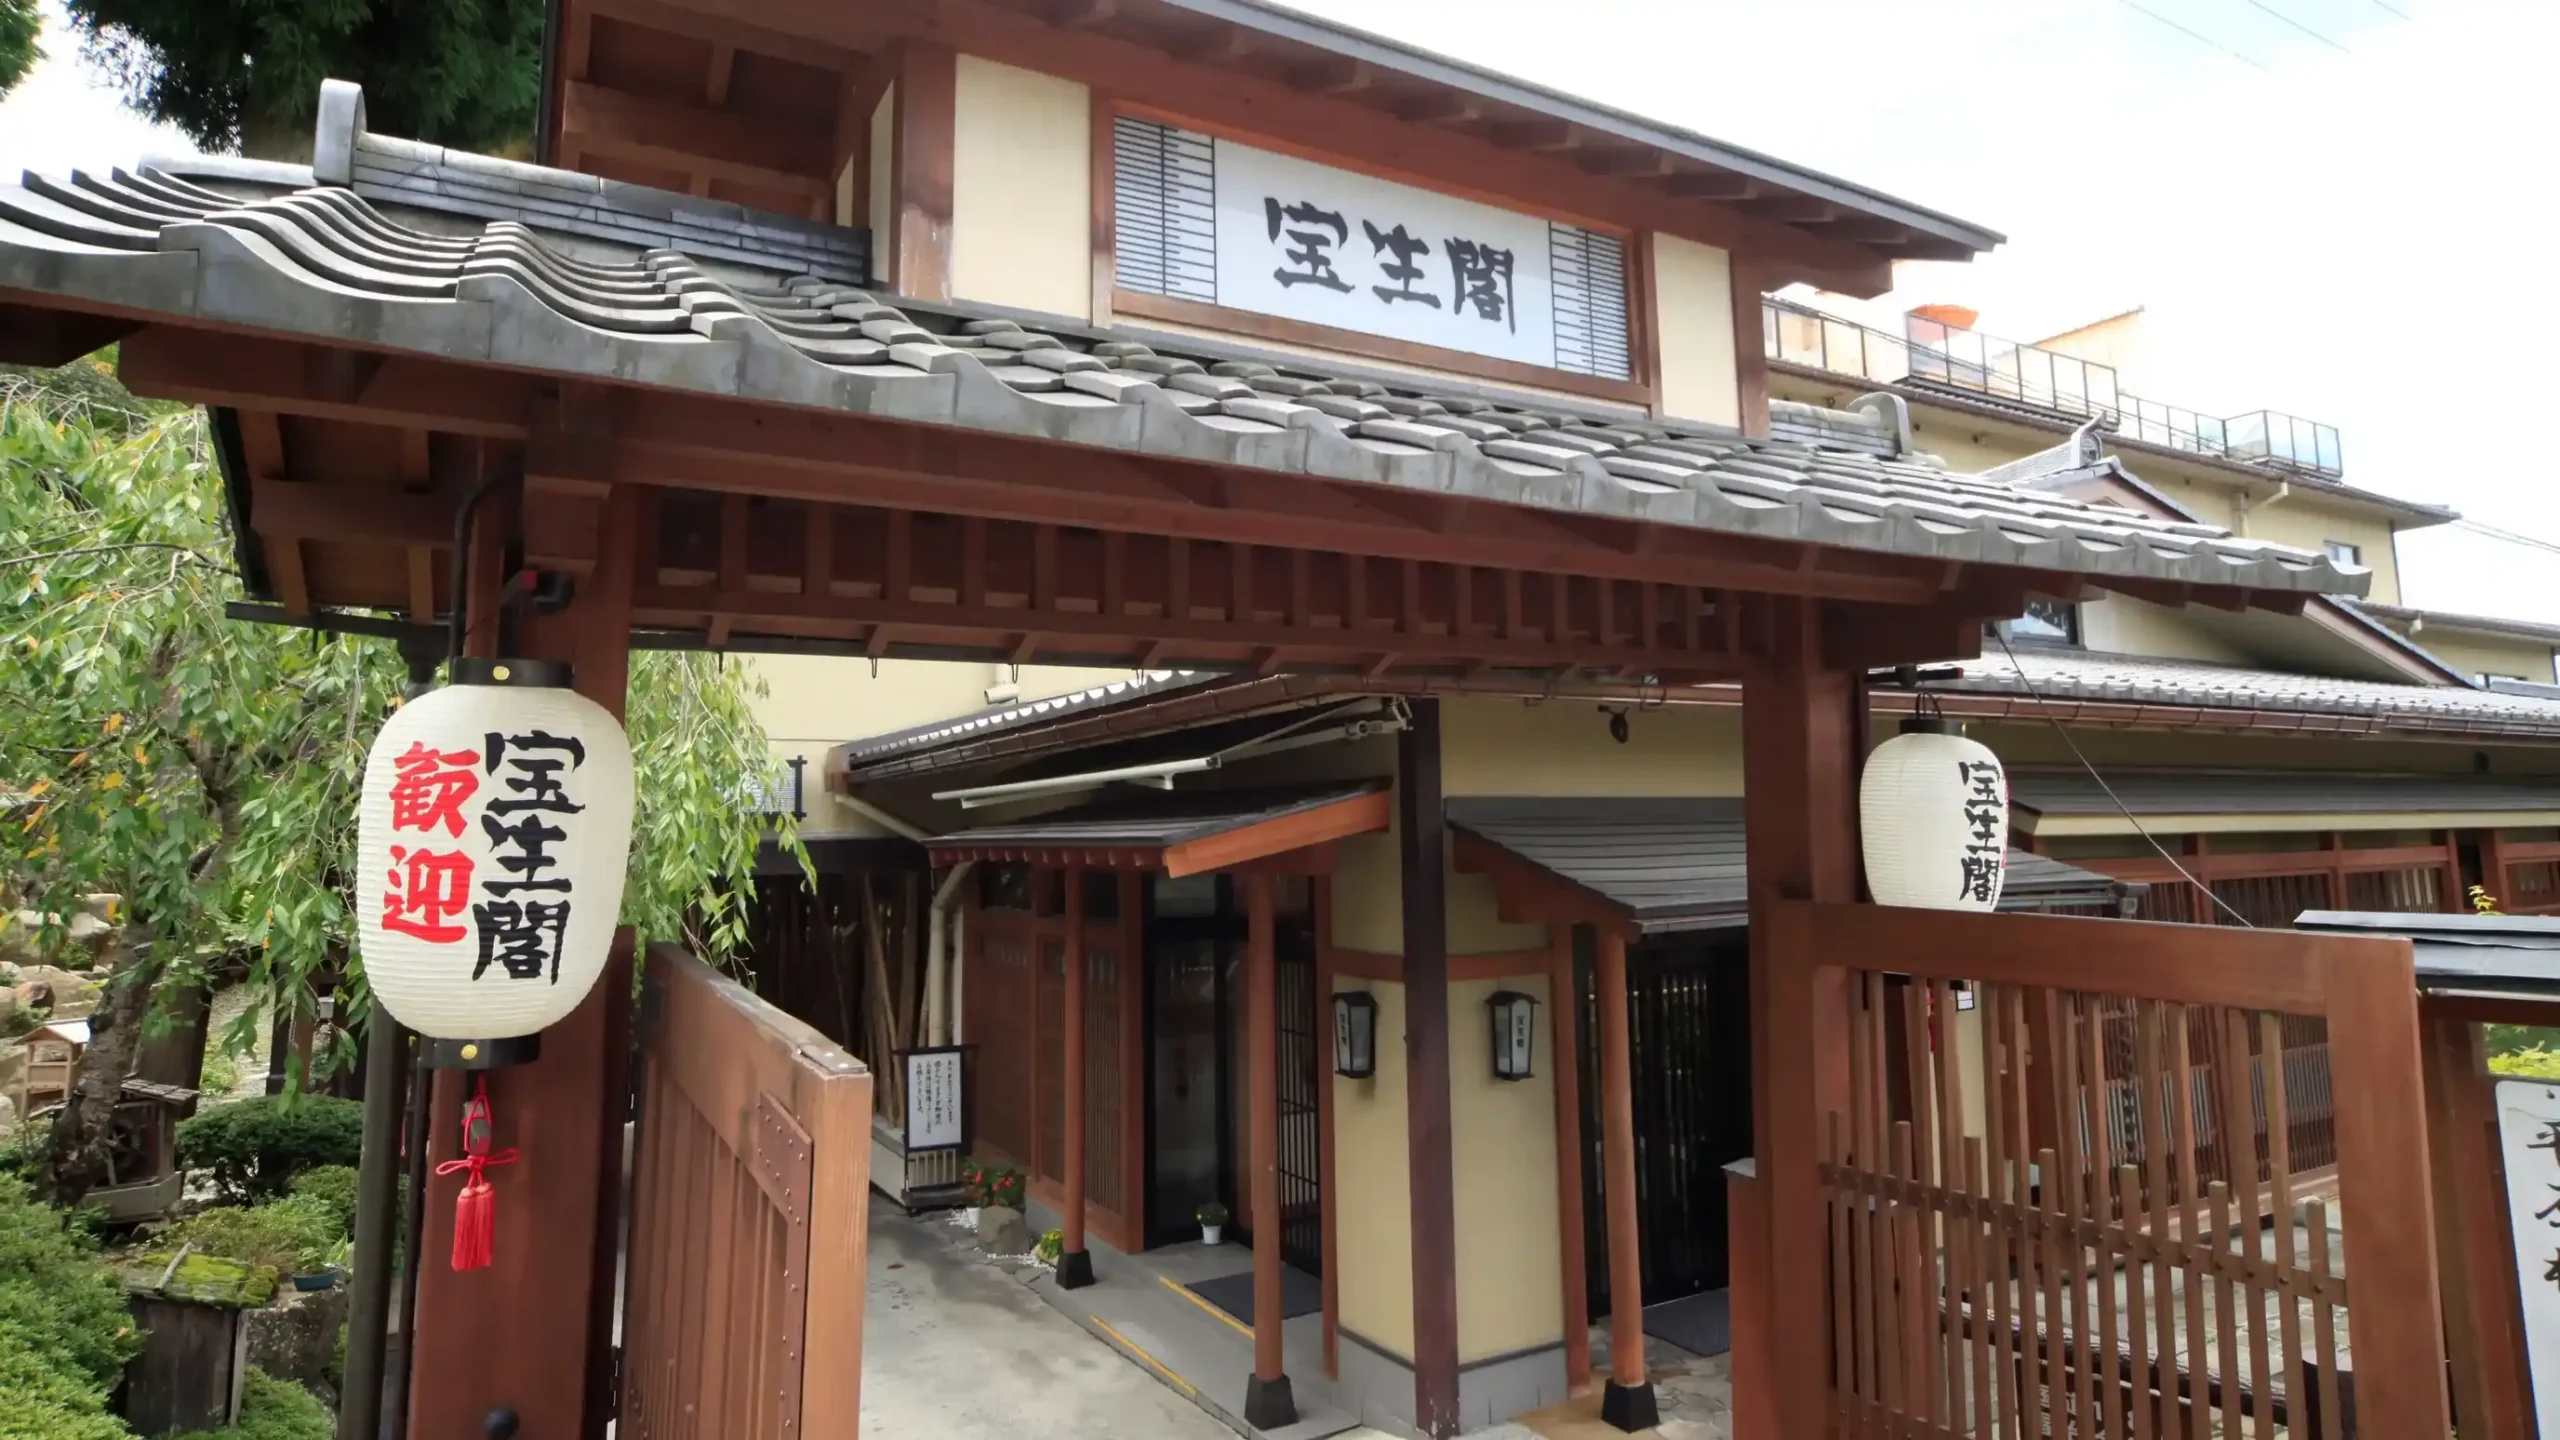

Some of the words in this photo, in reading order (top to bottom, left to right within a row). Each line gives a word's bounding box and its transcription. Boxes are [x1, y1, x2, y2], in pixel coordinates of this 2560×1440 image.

[1264, 197, 1515, 336] 宝生閣
[472, 729, 586, 986] 宝生閣
[1958, 760, 2003, 906] 宝生閣
